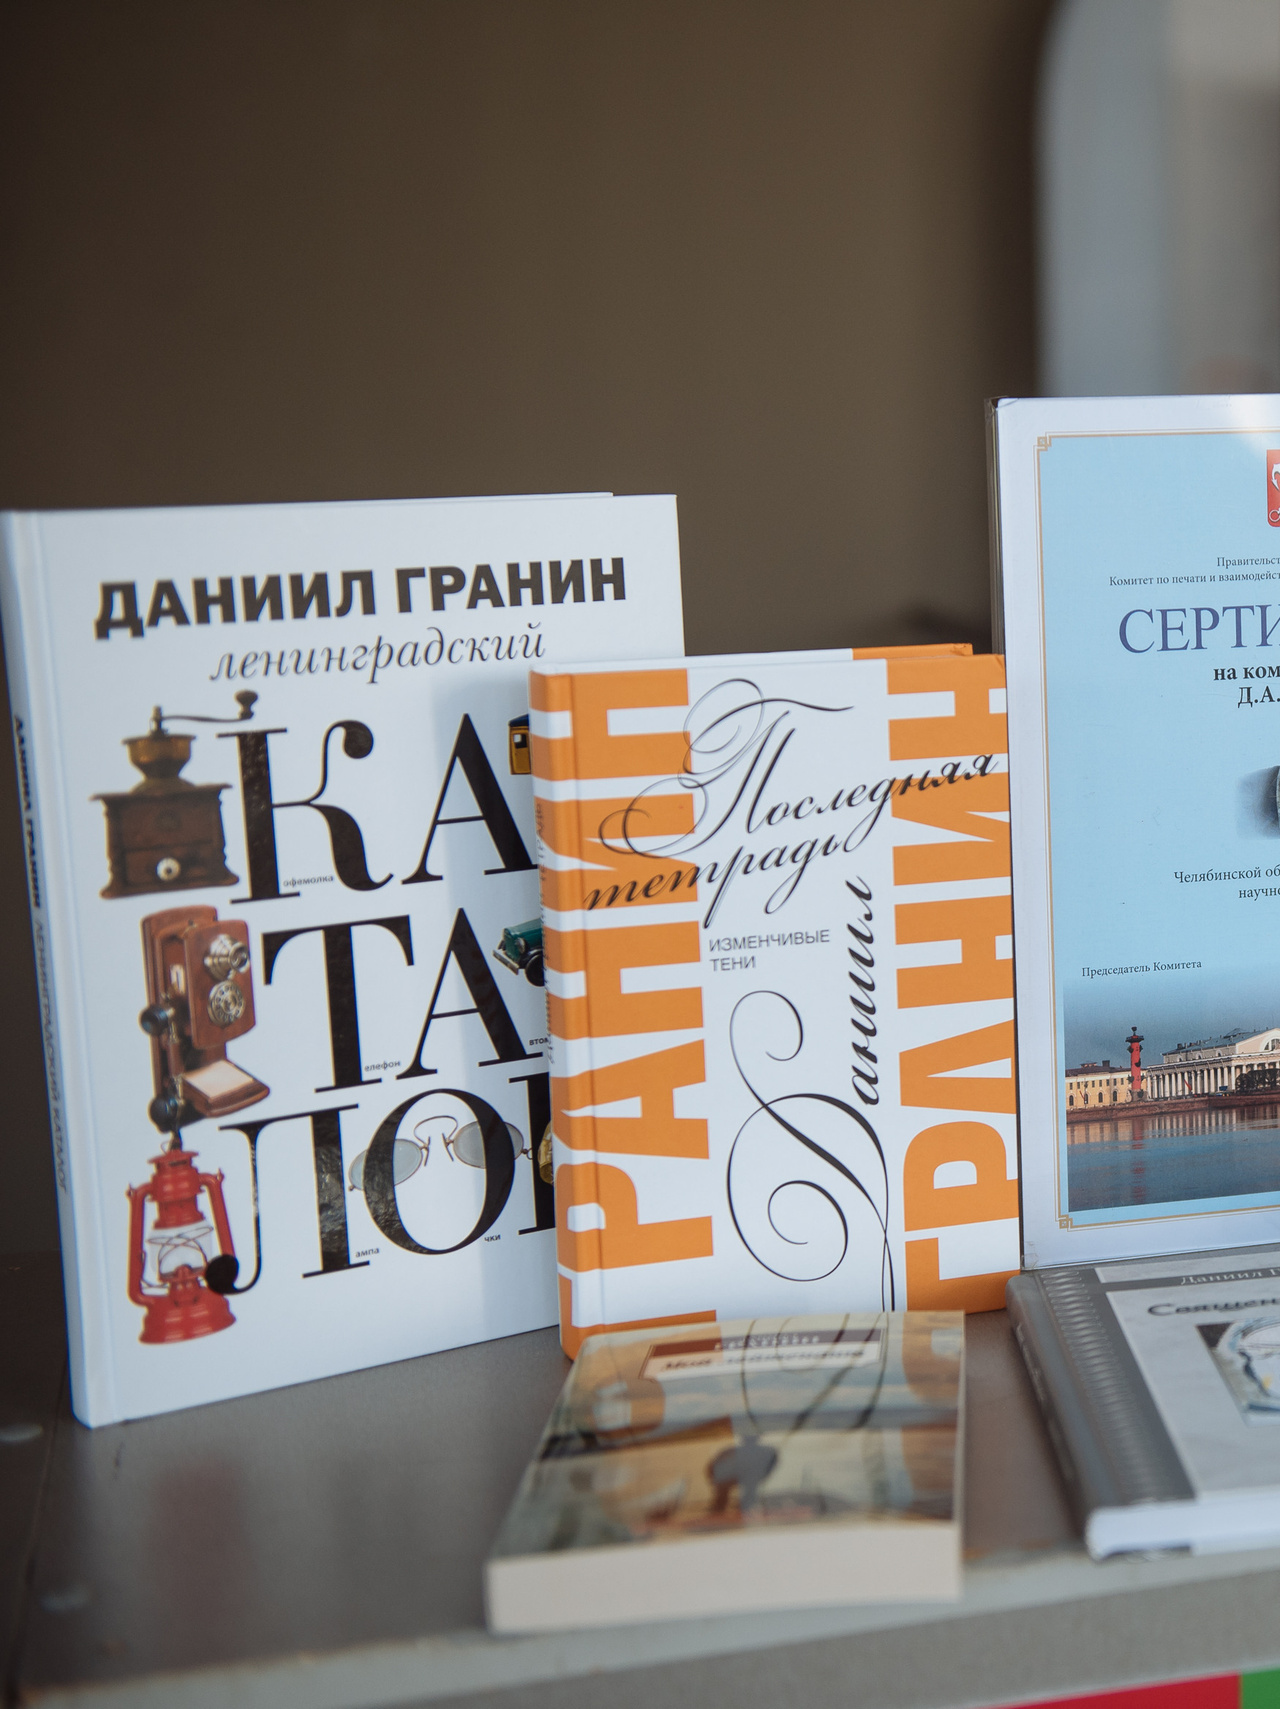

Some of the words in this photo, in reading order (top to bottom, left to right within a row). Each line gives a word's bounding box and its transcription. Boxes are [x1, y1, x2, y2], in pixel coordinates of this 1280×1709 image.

[1109, 575, 1154, 587] Комитет
[1156, 577, 1170, 587] по
[1171, 574, 1207, 586] печати
[1209, 574, 1216, 583] и
[94, 568, 378, 642] ДАНИИЛ
[395, 555, 628, 615] ГРАНИН
[209, 622, 548, 685] ленинградский
[1213, 665, 1238, 682] на
[1237, 686, 1280, 709] Д.А.
[598, 678, 999, 859] Последняя
[216, 712, 540, 905] КА
[582, 832, 851, 930] тетрадь
[1174, 865, 1262, 885] Челябинской
[708, 929, 831, 953] ИЗМЕНЧИВЫЕ
[709, 955, 757, 973] ТЕНИ
[1081, 963, 1151, 979] Председатель
[1153, 959, 1203, 973] Комитета
[261, 907, 545, 1093] ТА
[364, 1060, 401, 1072] елефон
[725, 874, 897, 1313] Даниил
[484, 1234, 501, 1243] чки
[355, 1247, 380, 1258] ампа
[1180, 1269, 1263, 1286] Даниил
